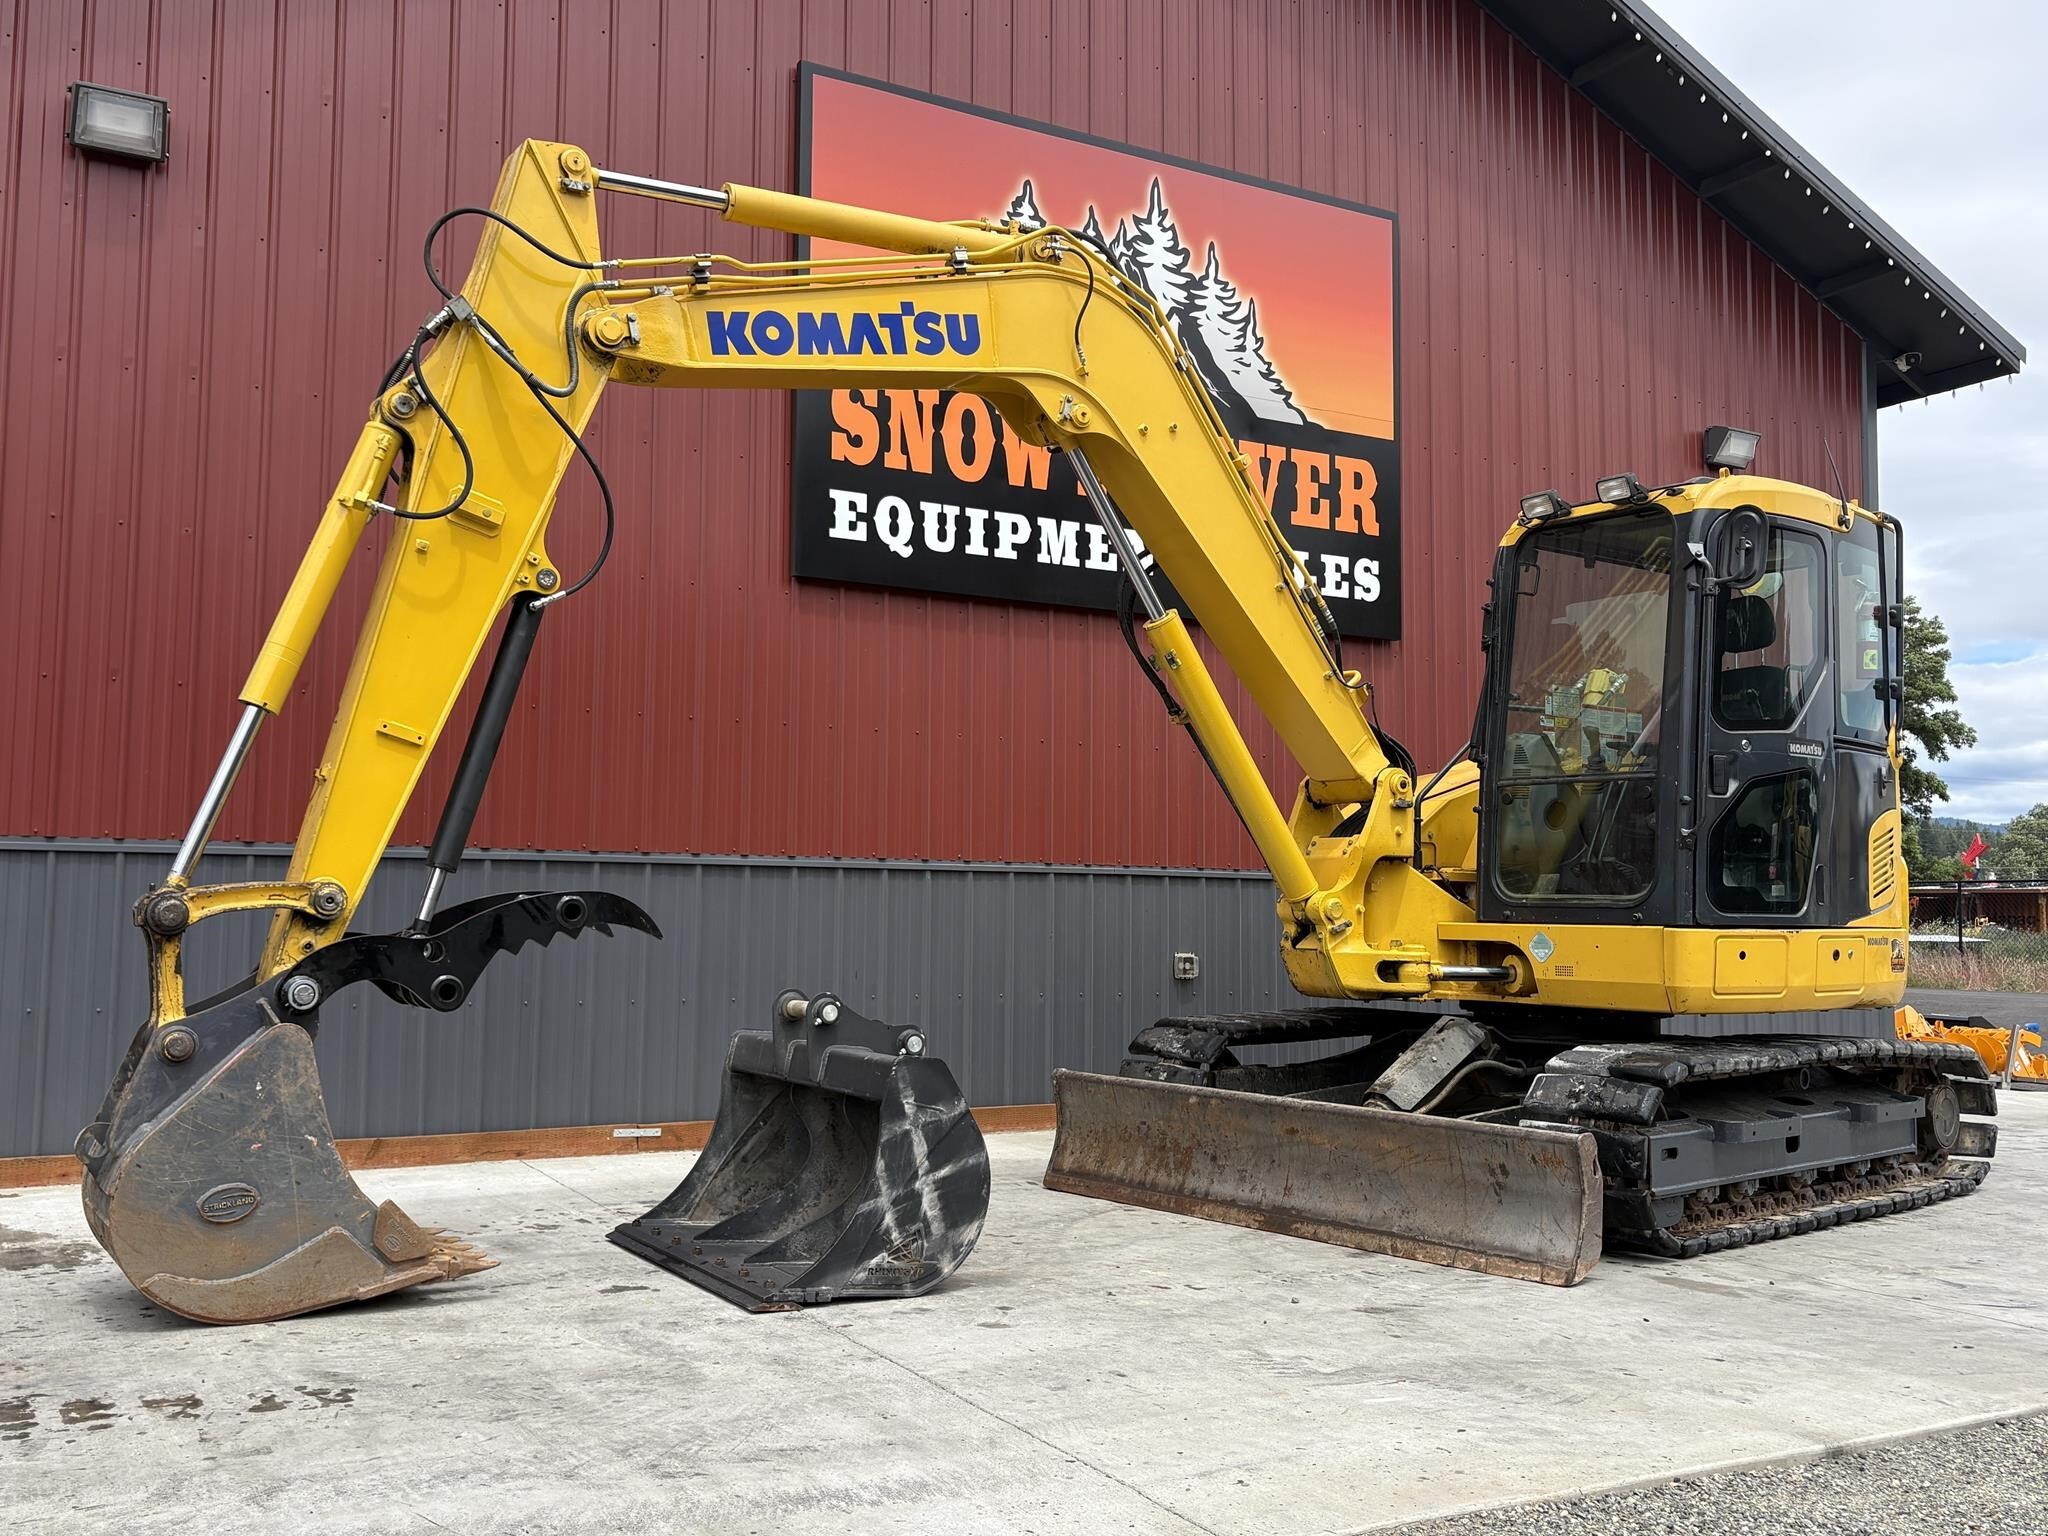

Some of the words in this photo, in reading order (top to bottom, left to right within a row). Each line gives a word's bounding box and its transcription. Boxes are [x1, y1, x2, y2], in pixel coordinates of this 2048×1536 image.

[705, 301, 981, 356] KOMATSU
[1790, 743, 1822, 756] KOMATSU
[204, 1196, 255, 1213] STRICKLAND
